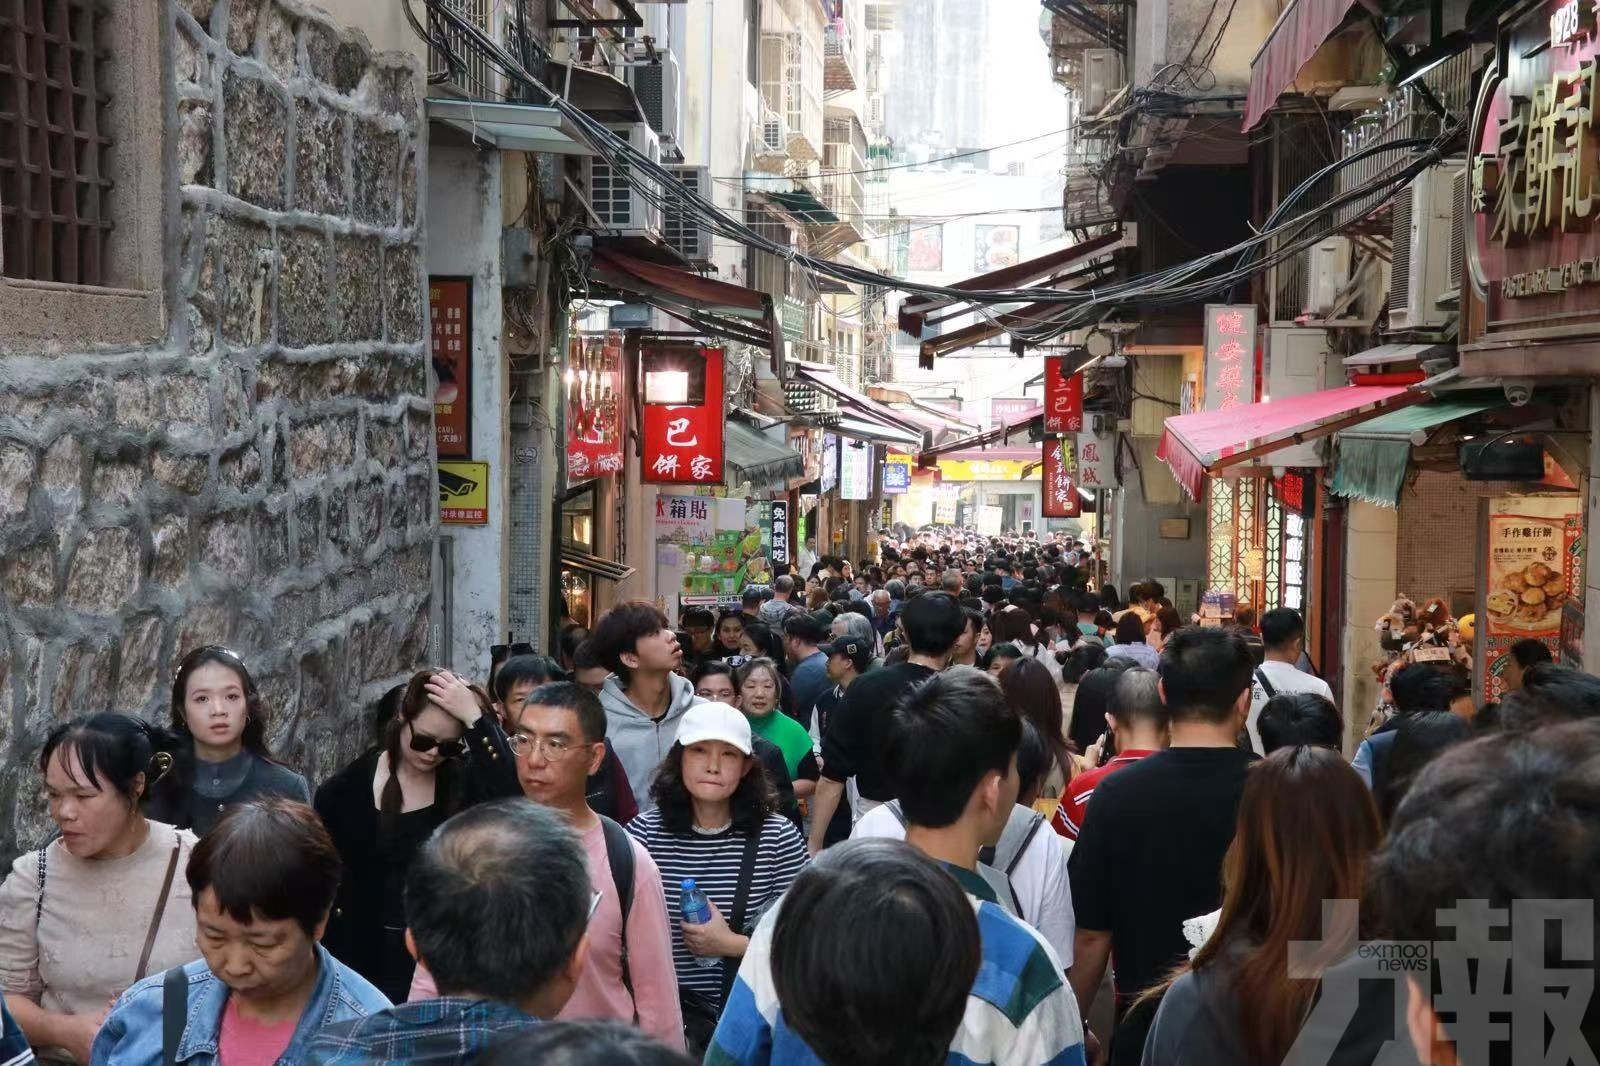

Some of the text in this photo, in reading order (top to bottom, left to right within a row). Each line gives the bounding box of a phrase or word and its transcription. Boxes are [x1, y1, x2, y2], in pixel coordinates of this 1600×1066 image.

[1550, 0, 1578, 48] 1928
[1560, 257, 1584, 288] YENG
[1053, 366, 1072, 413] 三巴
[665, 405, 697, 446] 巴
[652, 454, 714, 479] 餅家
[1082, 443, 1100, 485] 鳳城
[773, 507, 786, 562] 免費試吃
[1502, 527, 1552, 538] 手作雞仔餅
